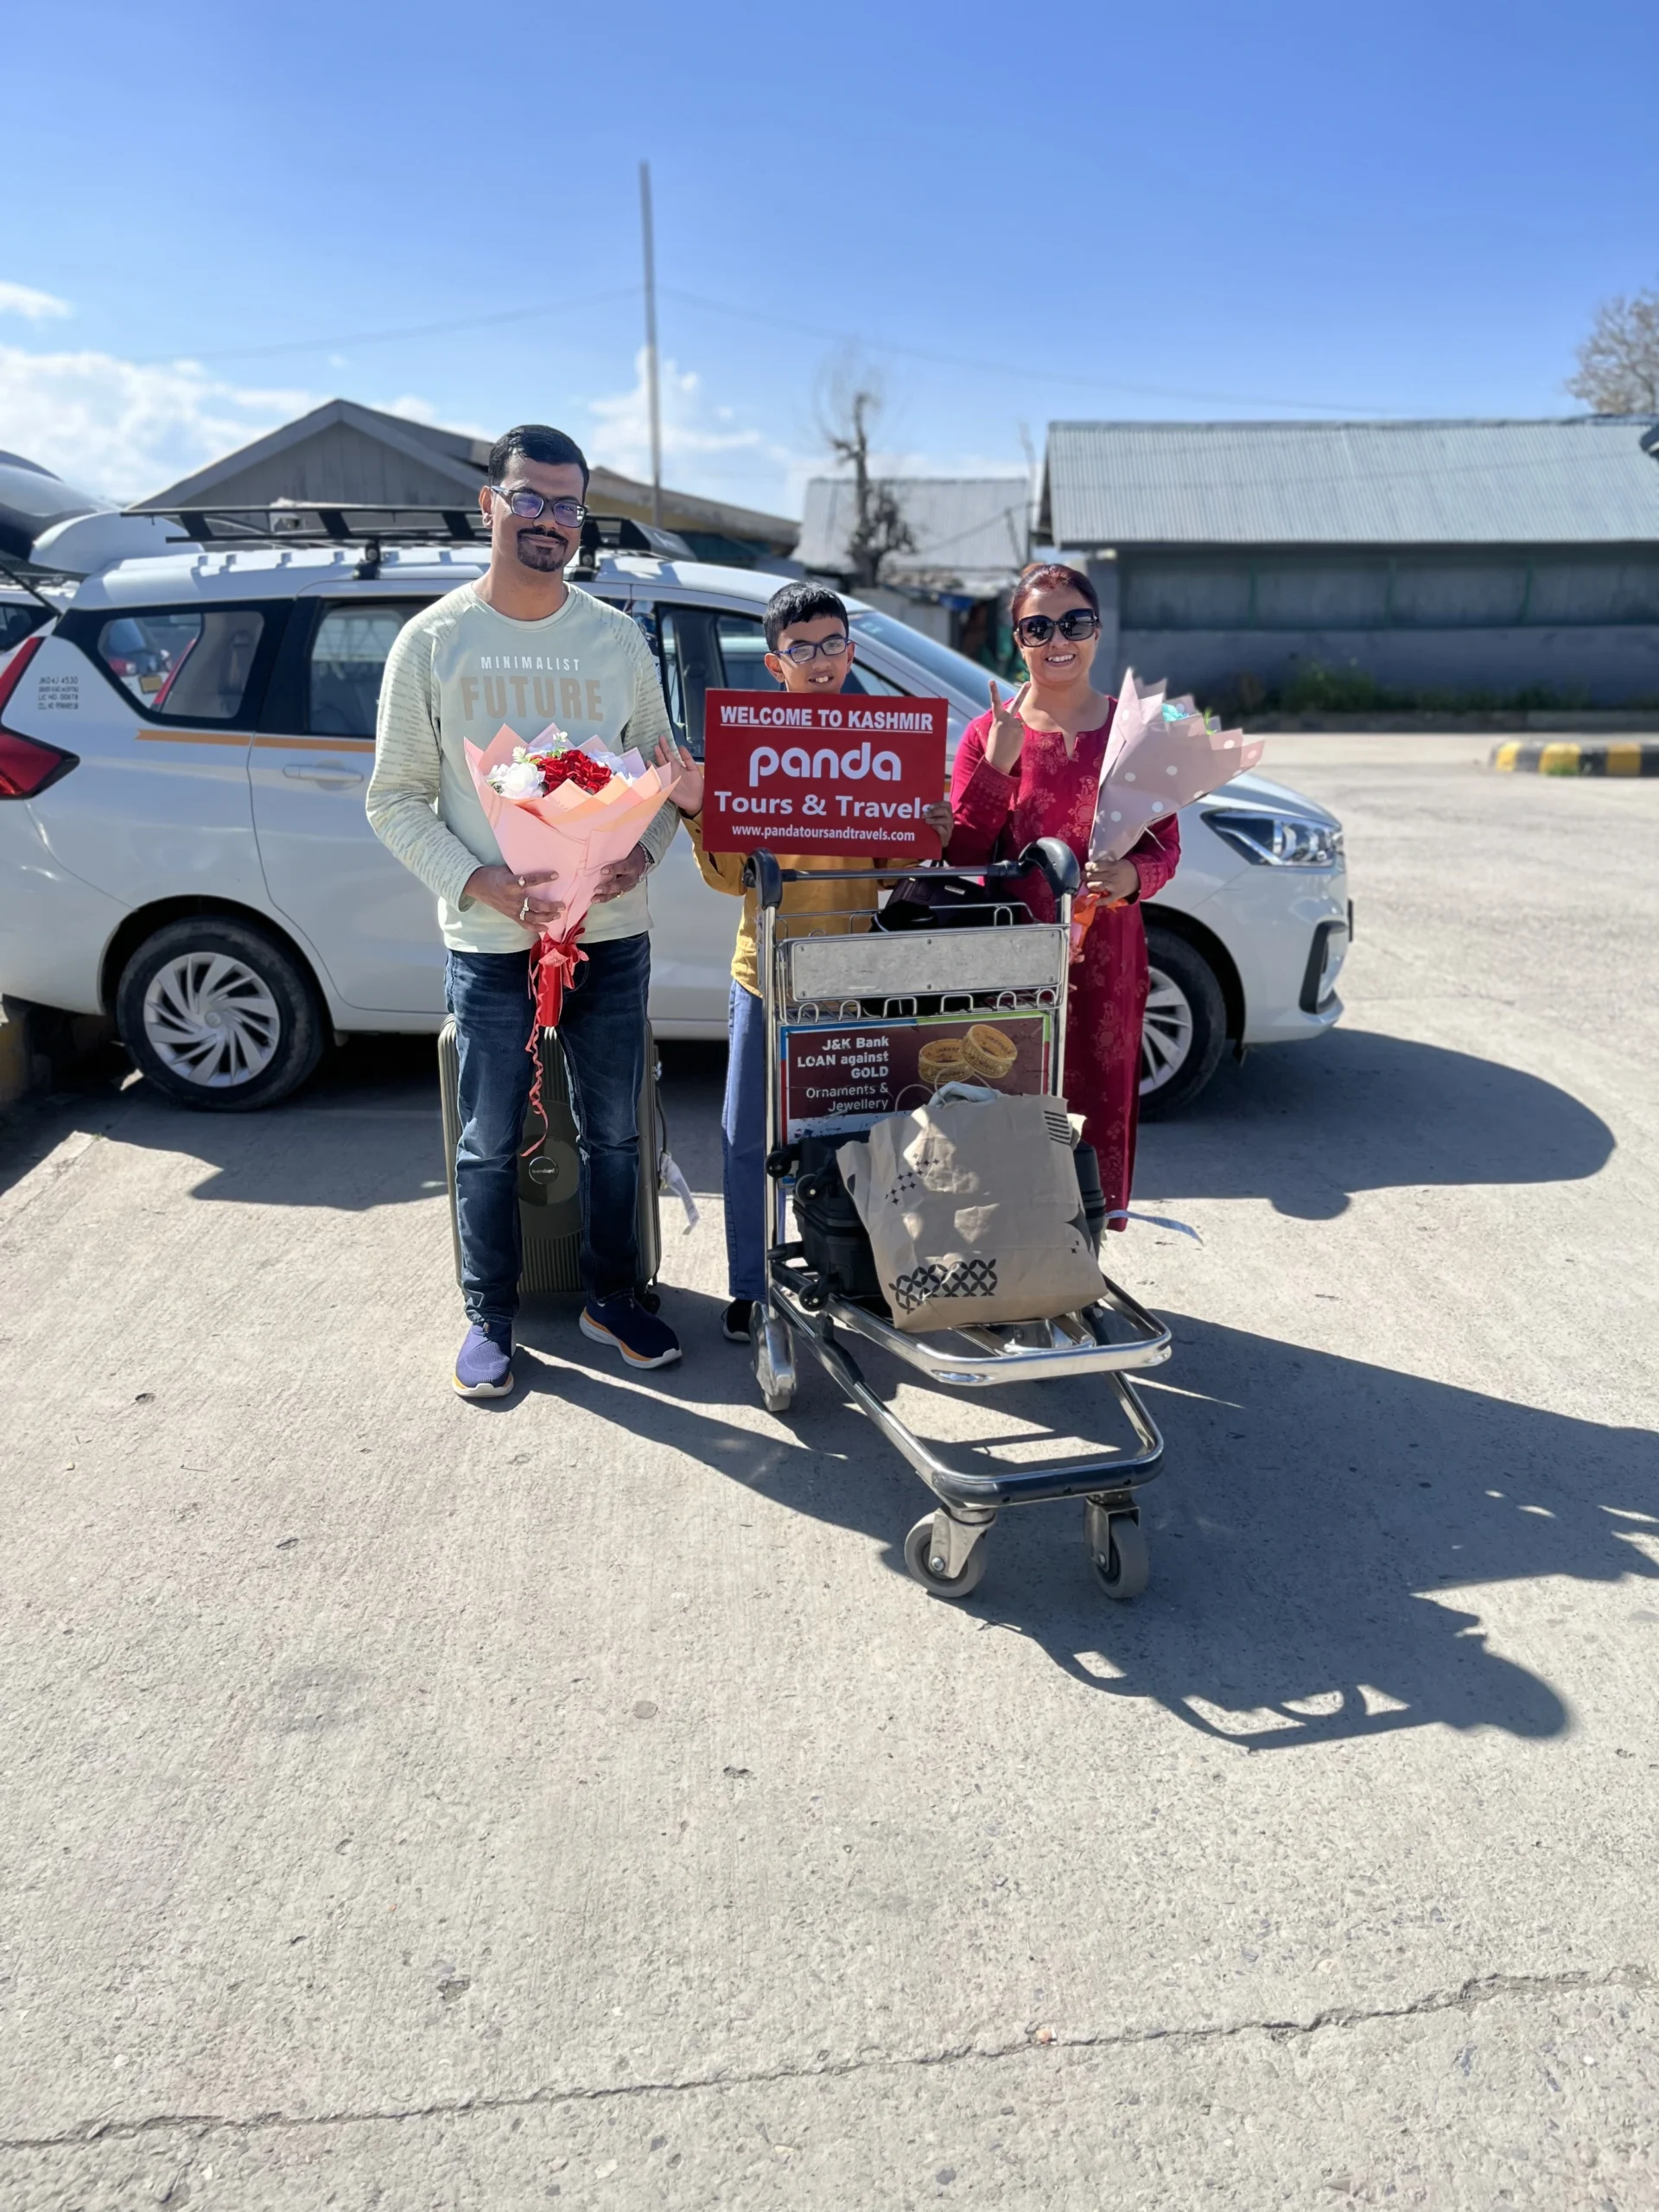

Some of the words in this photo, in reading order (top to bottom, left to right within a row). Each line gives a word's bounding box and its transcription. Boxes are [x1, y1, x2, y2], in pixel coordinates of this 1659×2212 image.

[480, 656, 580, 671] MINIMALIST
[461, 675, 603, 722] FUTURE
[721, 705, 812, 727] WELCOME
[818, 709, 842, 728] TO
[849, 710, 933, 731] KASHMIR
[749, 741, 902, 787] panda
[714, 791, 793, 815] Tours
[802, 794, 827, 816] &
[732, 823, 915, 842] www.pandatoursandtravels.com
[822, 1038, 852, 1051] J&K
[856, 1035, 889, 1049] Bank
[798, 1054, 836, 1068] LOAN
[841, 1051, 889, 1067] against
[851, 1065, 889, 1079] GOLD
[806, 1083, 876, 1099] Ornaments
[880, 1082, 889, 1094] &
[828, 1098, 889, 1112] Jewellery
